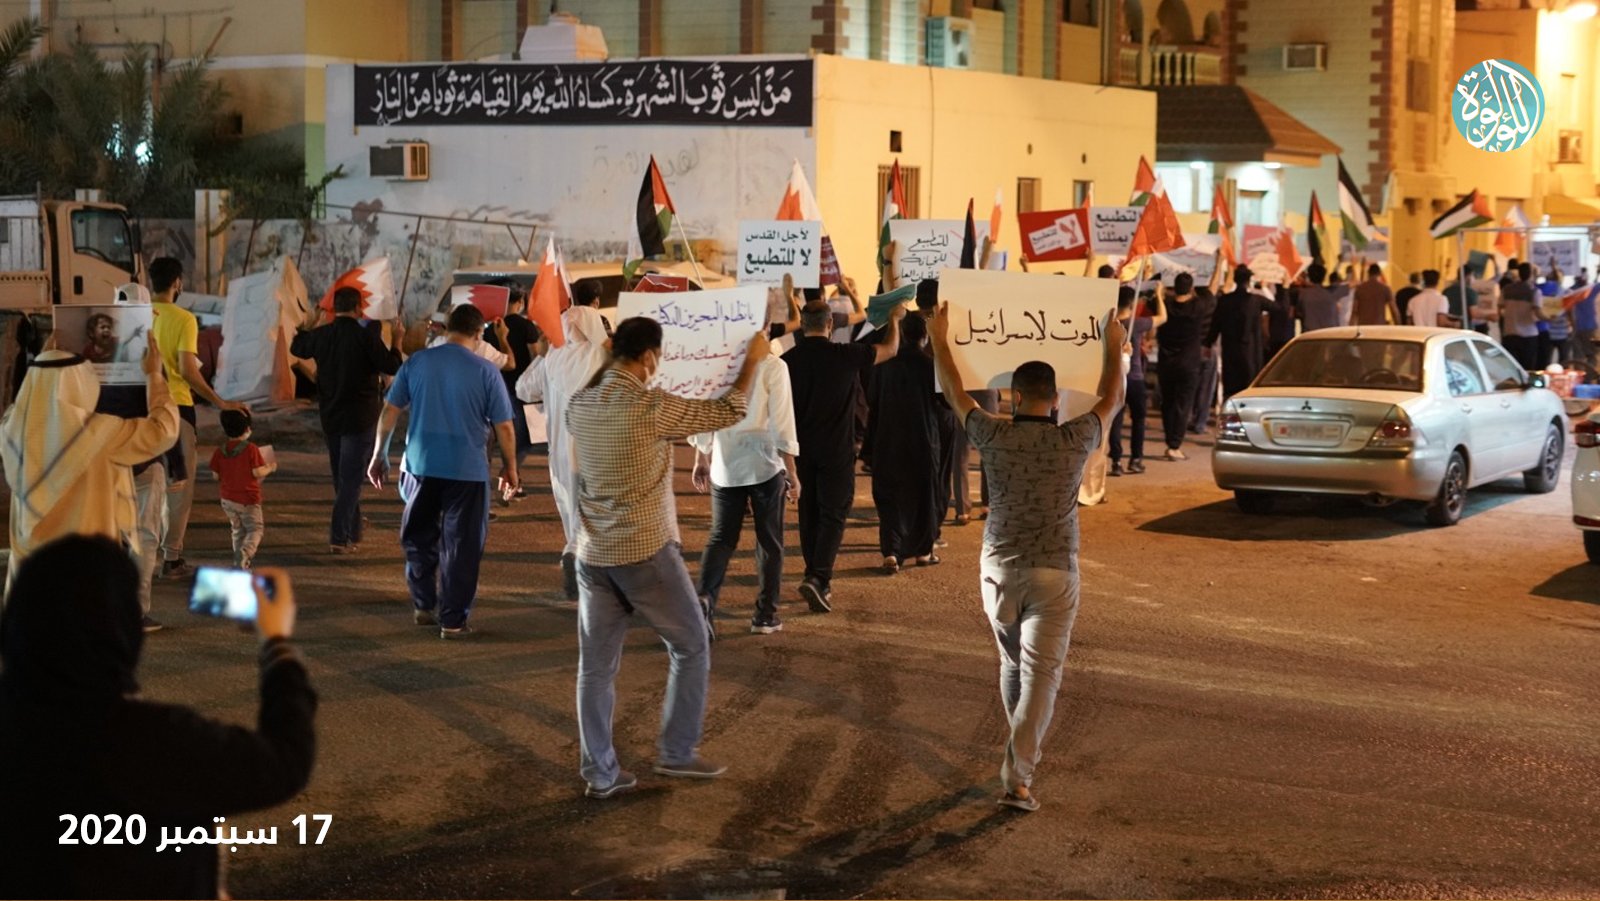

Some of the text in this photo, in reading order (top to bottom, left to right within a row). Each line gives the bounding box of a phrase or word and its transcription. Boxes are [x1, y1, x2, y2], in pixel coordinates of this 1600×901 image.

[745, 229, 780, 242] القدس
[744, 247, 795, 275] للتطبيع
[800, 247, 812, 266] لا
[1049, 315, 1102, 347] الموت
